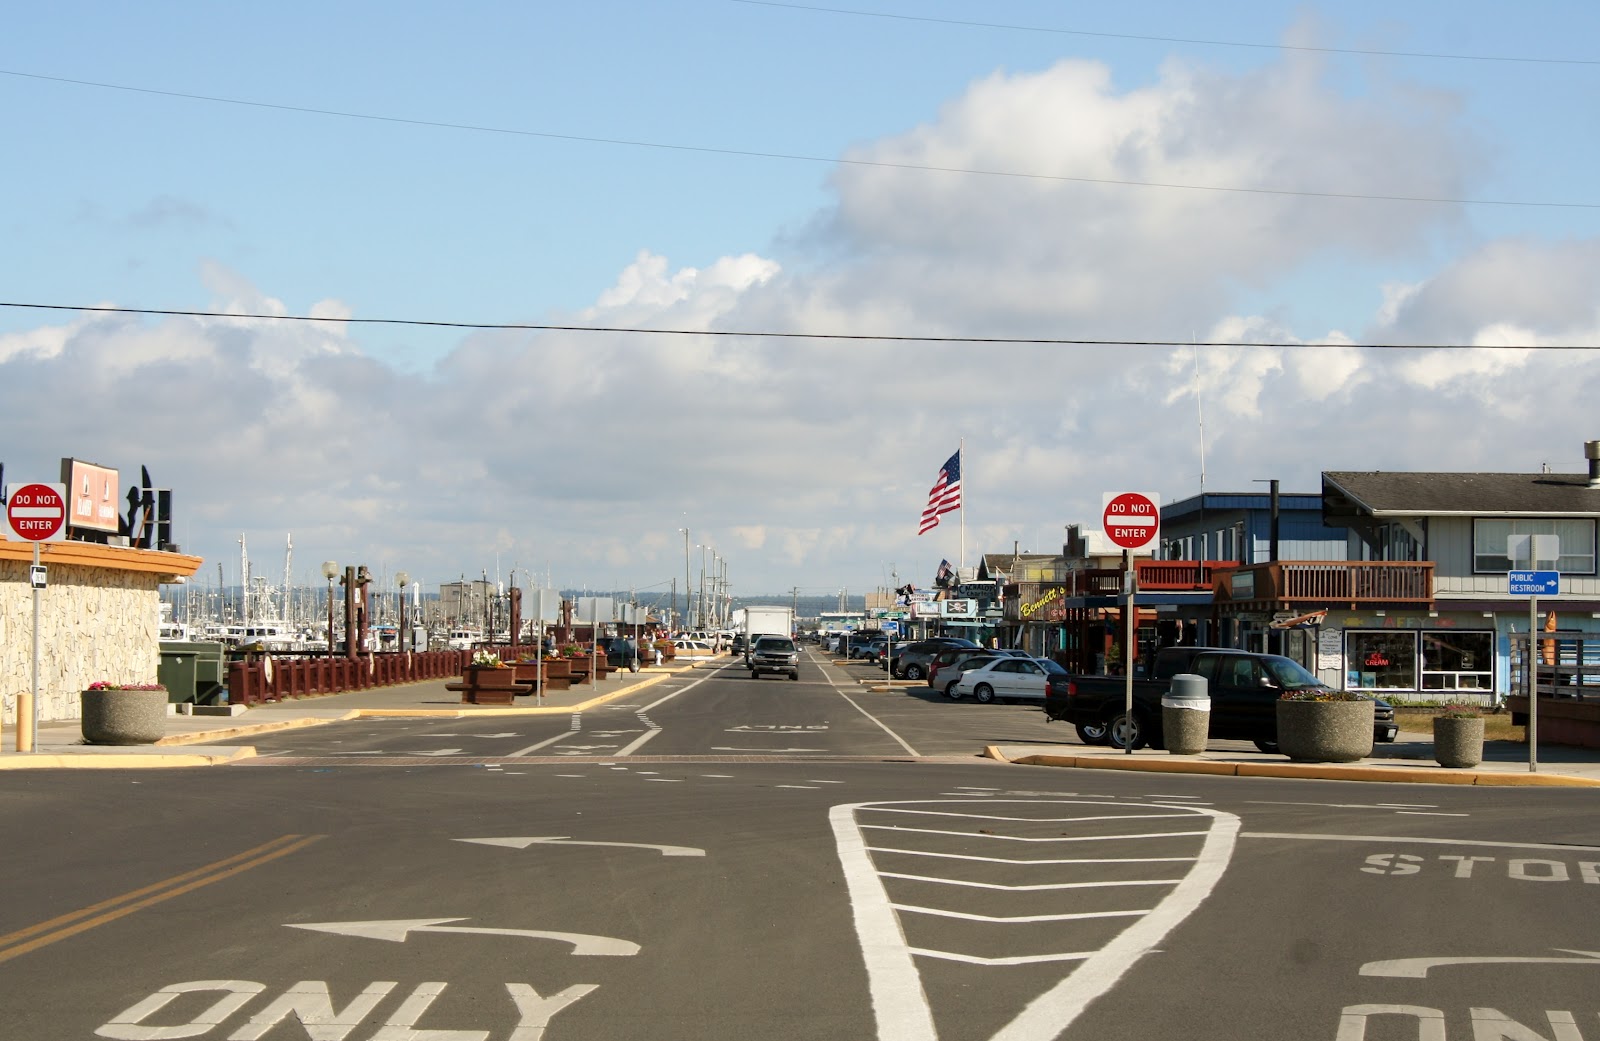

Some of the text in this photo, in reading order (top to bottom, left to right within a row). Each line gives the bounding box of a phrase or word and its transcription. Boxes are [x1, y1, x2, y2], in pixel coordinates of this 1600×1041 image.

[16, 495, 57, 505] DO NOT
[1111, 503, 1151, 513] DO NOT
[20, 520, 53, 530] ENTER
[1114, 528, 1147, 538] ENTER
[1510, 574, 1534, 582] PUBLIC
[1510, 584, 1546, 592] RESTROOM
[1020, 586, 1066, 617] Bennett's
[94, 980, 600, 1041] ONLY
[1335, 1003, 1600, 1041] ON
